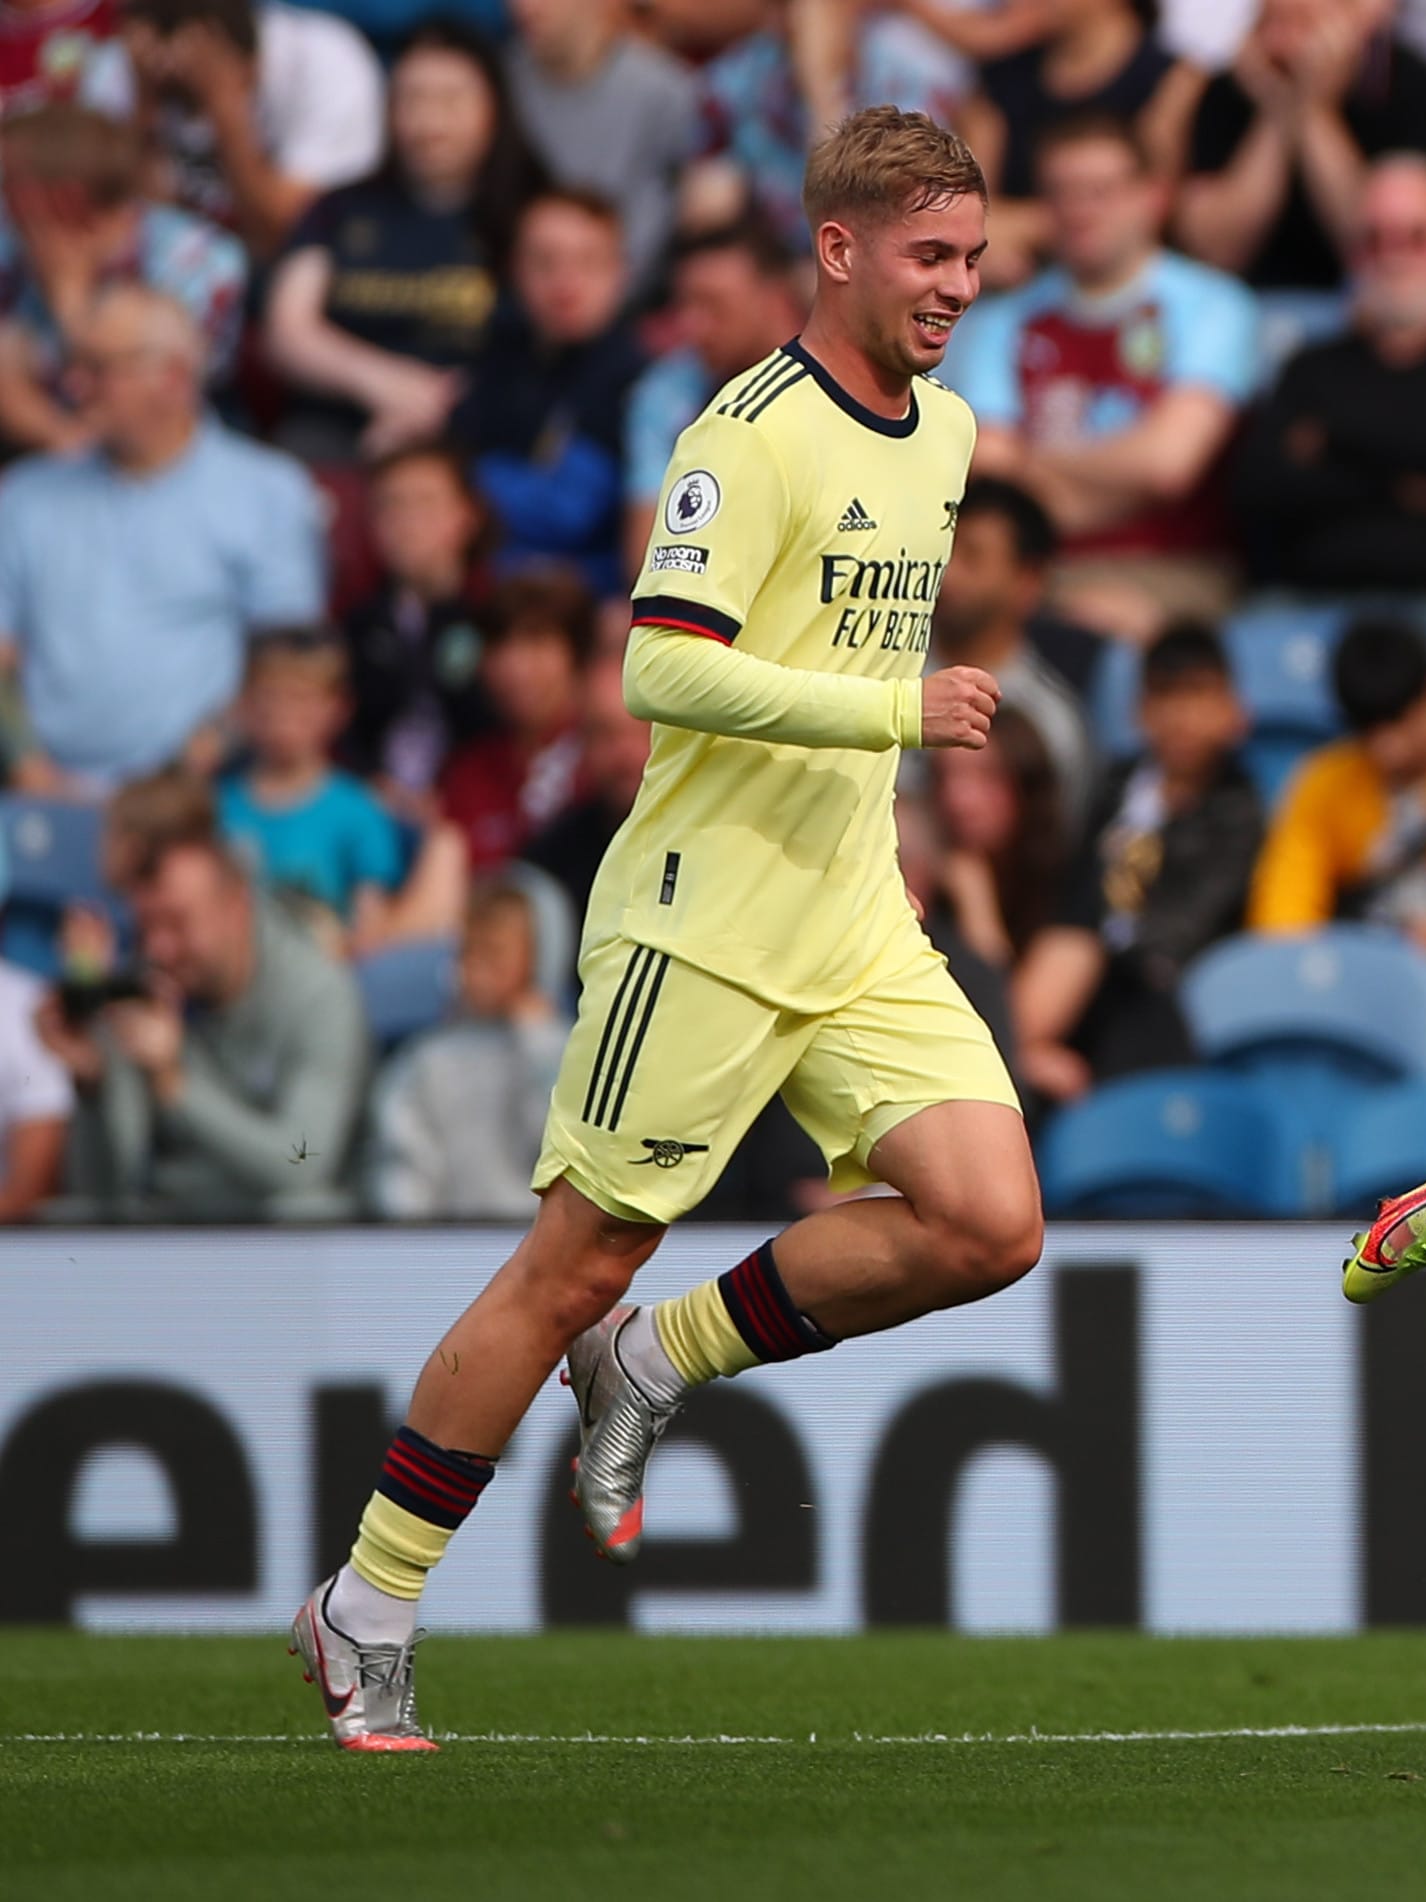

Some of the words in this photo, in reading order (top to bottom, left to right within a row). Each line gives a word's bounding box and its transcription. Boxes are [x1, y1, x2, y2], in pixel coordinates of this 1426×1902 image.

[838, 519, 877, 532] adidas
[654, 548, 667, 561] No
[667, 547, 702, 562] room
[820, 547, 946, 604] Emirat
[832, 608, 882, 649] FLY
